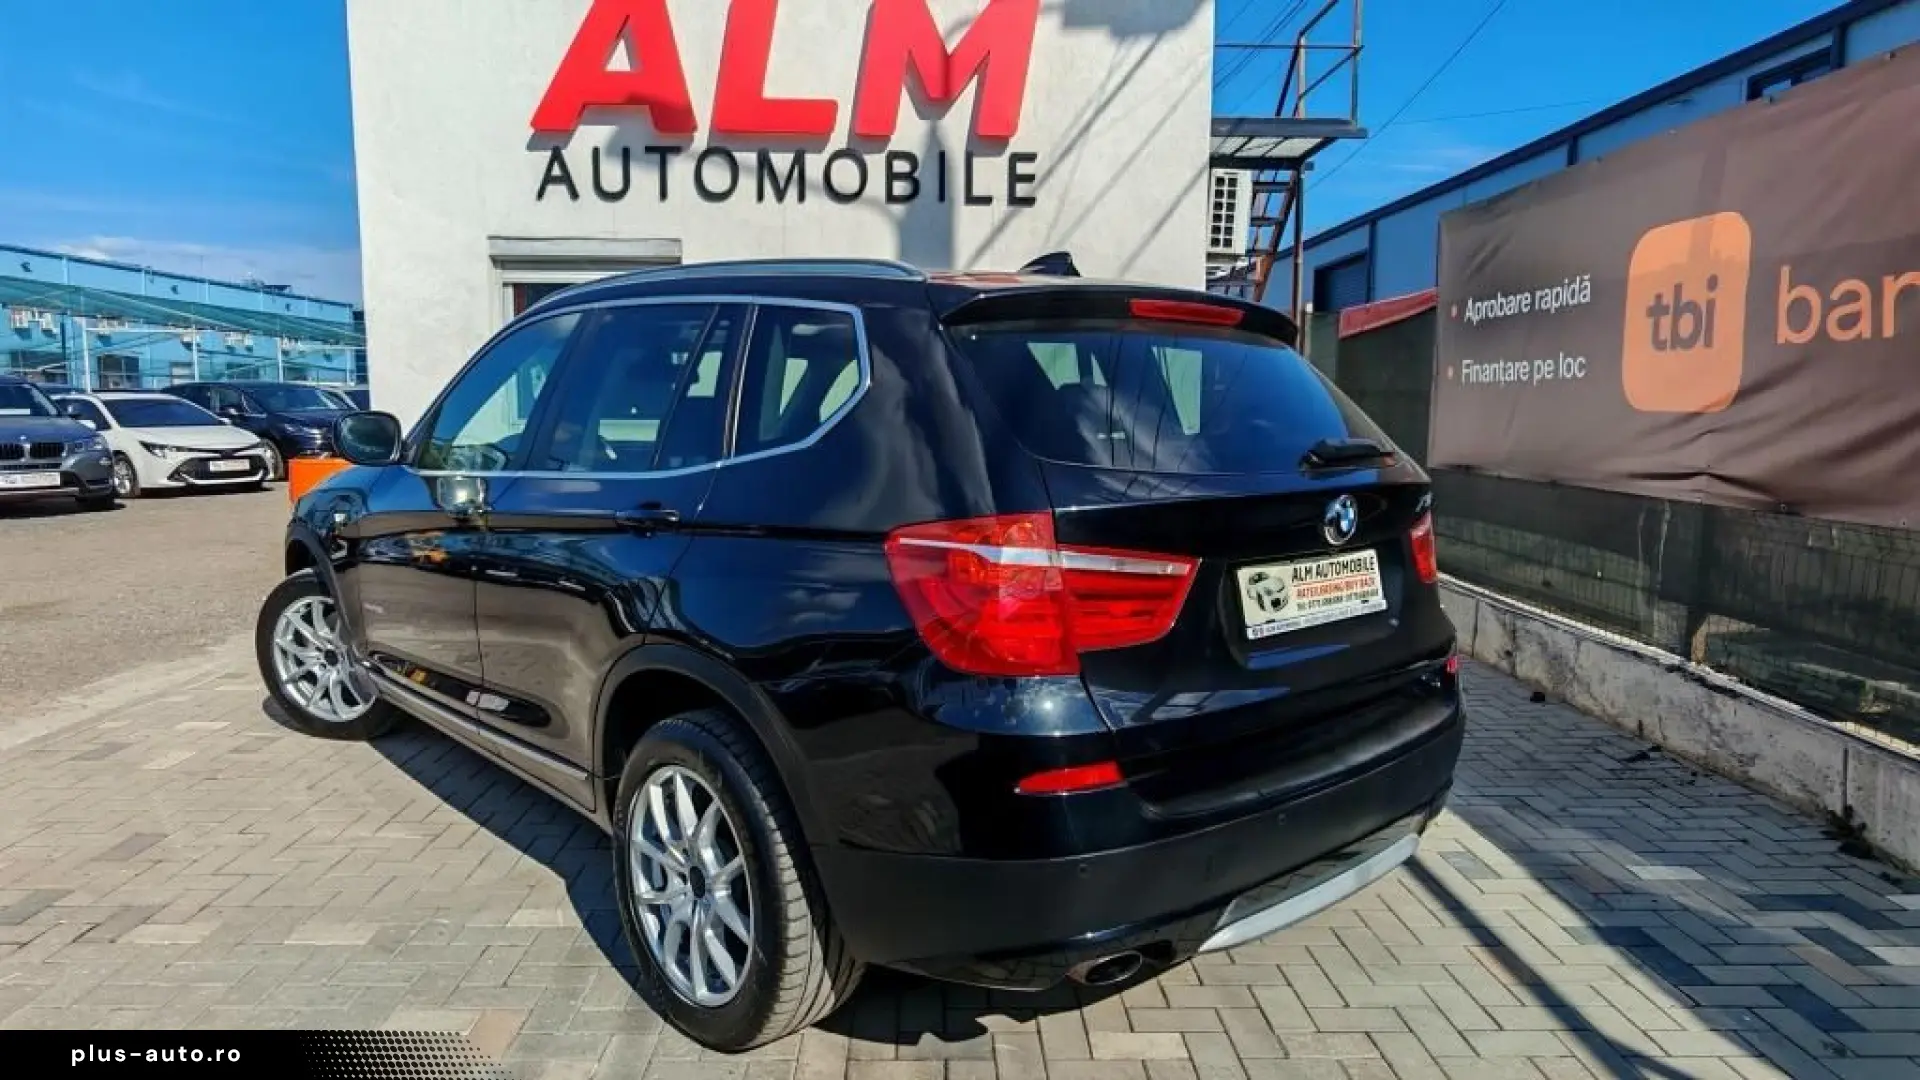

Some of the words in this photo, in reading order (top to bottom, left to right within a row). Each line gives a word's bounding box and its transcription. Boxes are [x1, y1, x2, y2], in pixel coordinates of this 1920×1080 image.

[530, 0, 1040, 137] ALM
[536, 146, 1037, 208] AUTOMOBILE
[1464, 291, 1531, 326] Aprobare
[1535, 273, 1591, 314] rapidă
[1646, 273, 1719, 351] tbi
[1533, 359, 1555, 386] pe
[1559, 351, 1587, 380] loc
[1292, 565, 1314, 582] ALM
[1316, 556, 1376, 579] AUTOMOBILE
